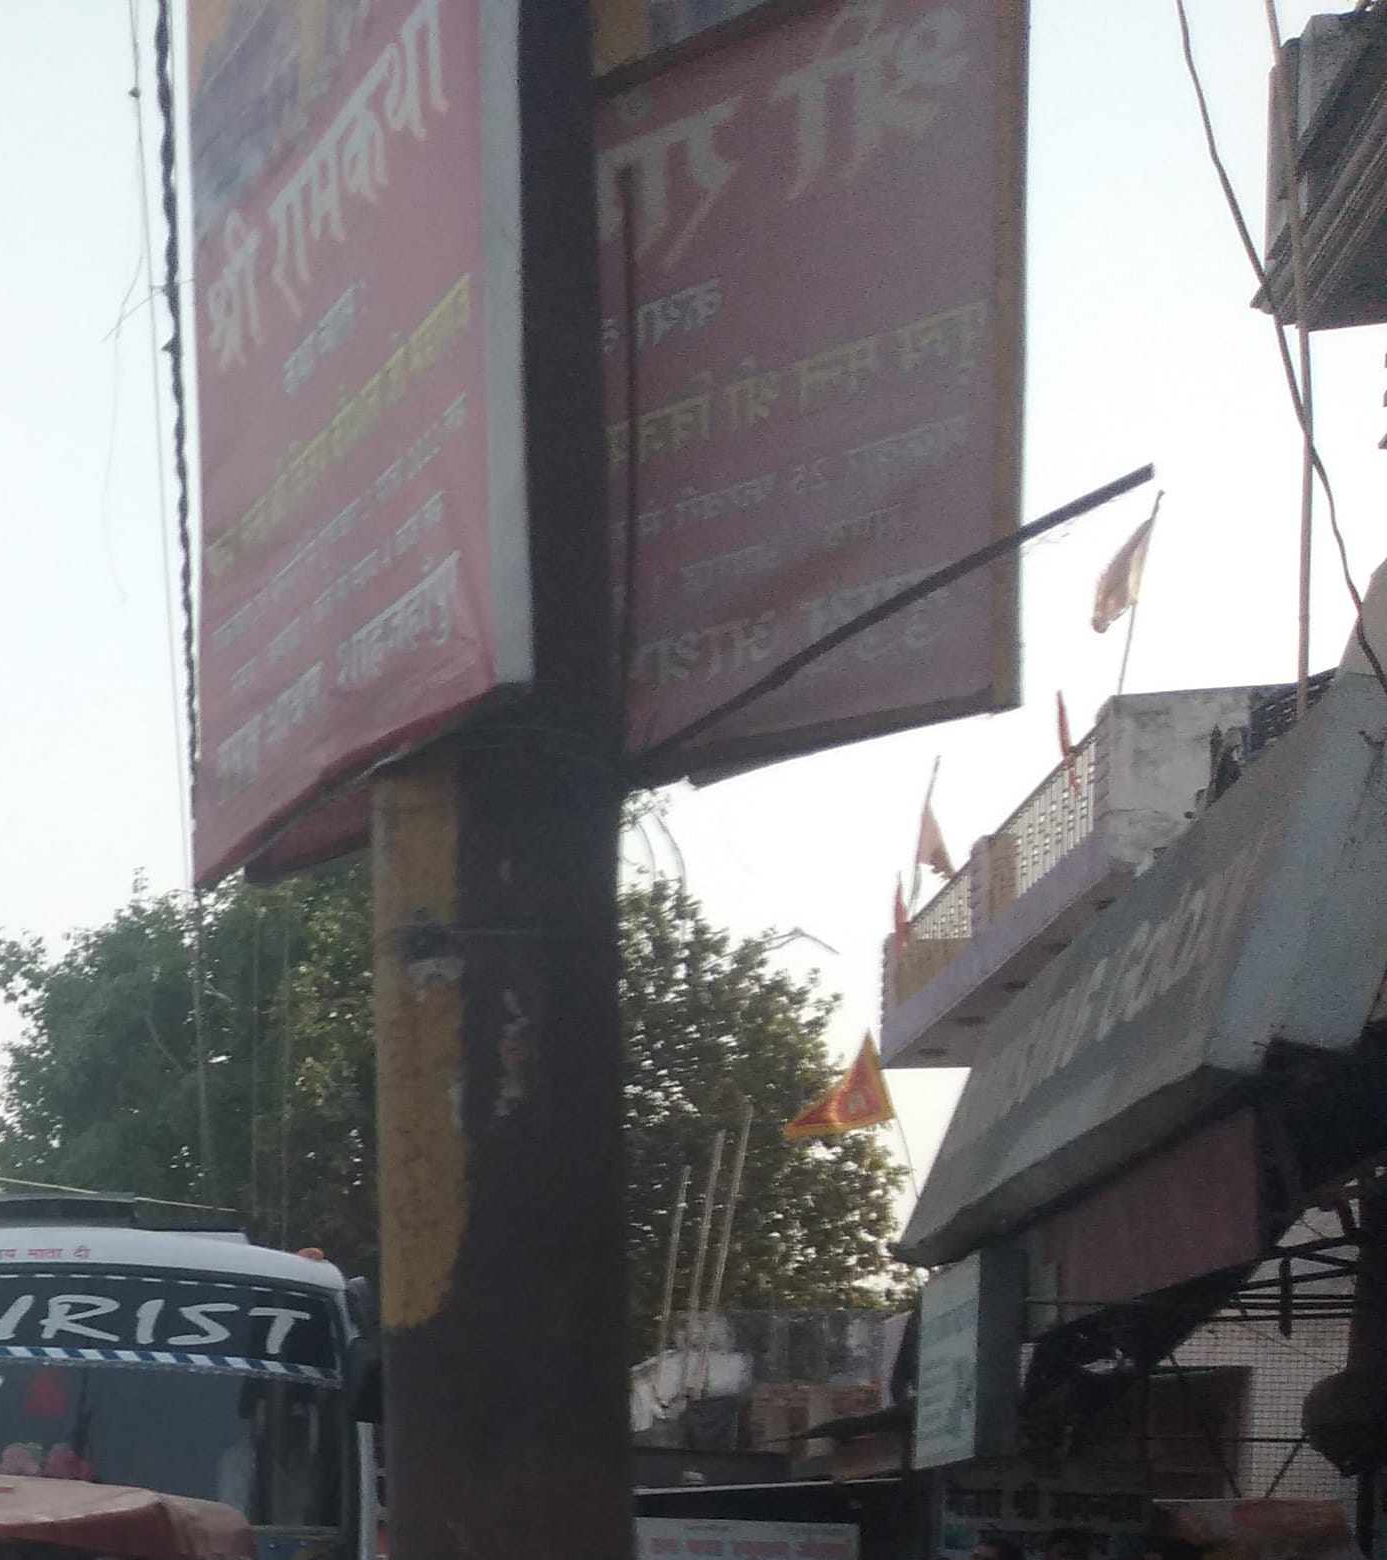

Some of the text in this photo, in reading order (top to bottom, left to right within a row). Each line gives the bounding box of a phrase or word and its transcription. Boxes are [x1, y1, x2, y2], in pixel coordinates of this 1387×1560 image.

[207, 208, 263, 371] श्री
[28, 1248, 63, 1260] माता
[74, 1246, 90, 1260] दी
